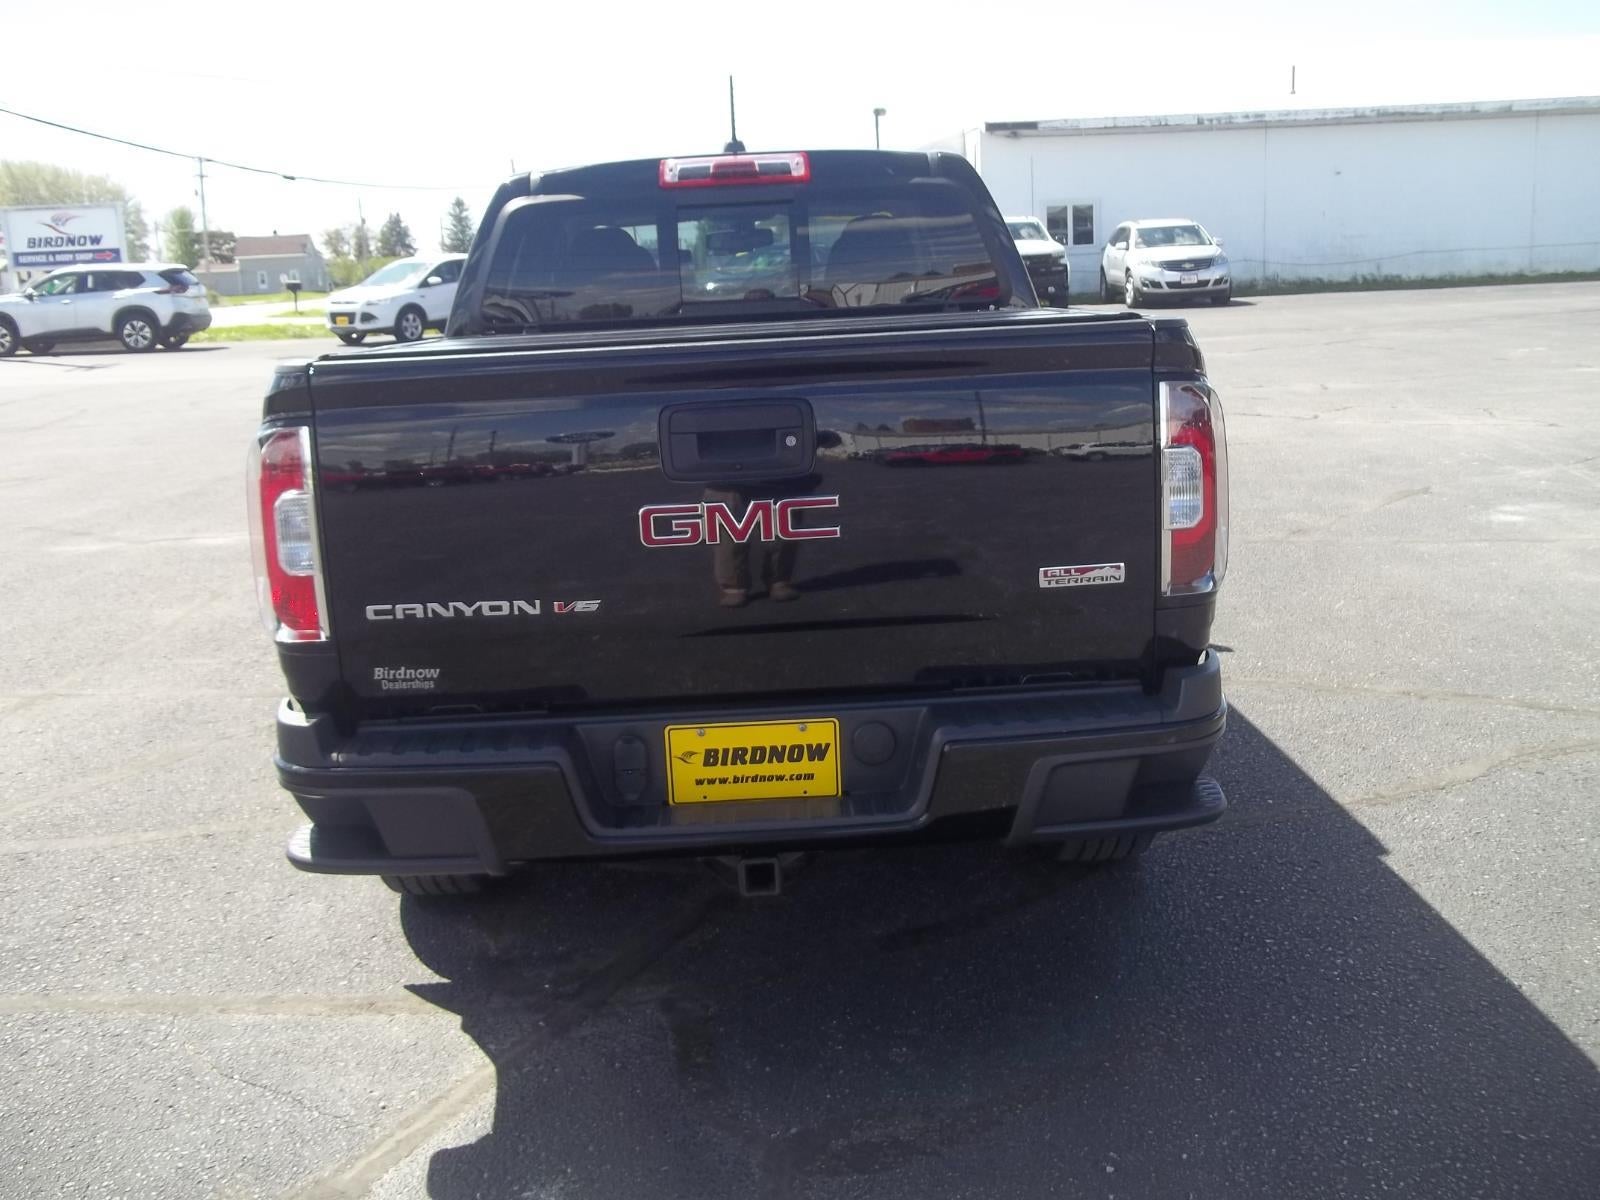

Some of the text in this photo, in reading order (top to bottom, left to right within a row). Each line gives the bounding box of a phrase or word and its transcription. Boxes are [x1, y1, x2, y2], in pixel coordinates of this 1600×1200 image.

[27, 235, 103, 249] BIRDNOW
[639, 495, 840, 547] GMC
[1047, 568, 1080, 577] ALL
[1043, 575, 1121, 586] TERRAIN
[365, 600, 601, 620] CANYON V6
[374, 667, 440, 679] Birdnow
[381, 679, 435, 690] Dealerships
[702, 743, 831, 767] BIRDNOW
[695, 772, 815, 786] www.birdnow.com
